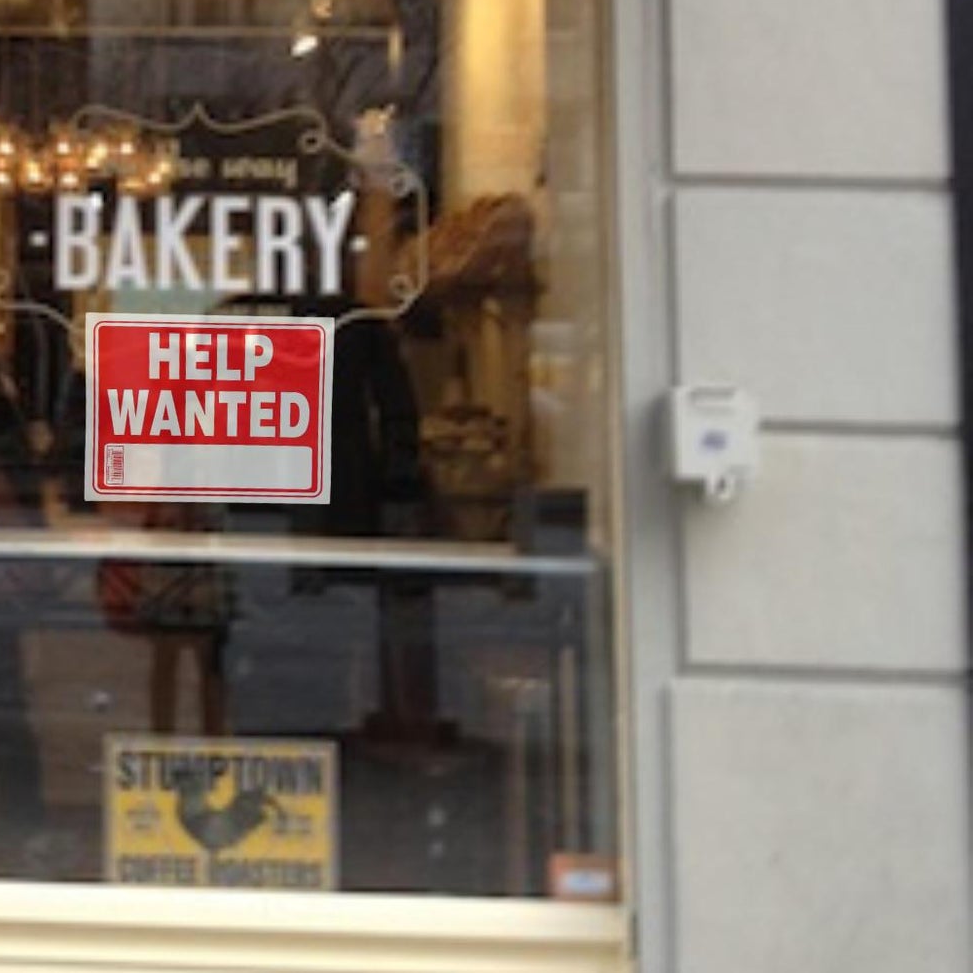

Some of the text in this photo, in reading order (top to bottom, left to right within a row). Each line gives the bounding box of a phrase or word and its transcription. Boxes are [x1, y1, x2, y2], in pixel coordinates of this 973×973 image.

[54, 191, 356, 295] BAKERY
[148, 332, 274, 382] HELP
[107, 389, 311, 438] WANTED
